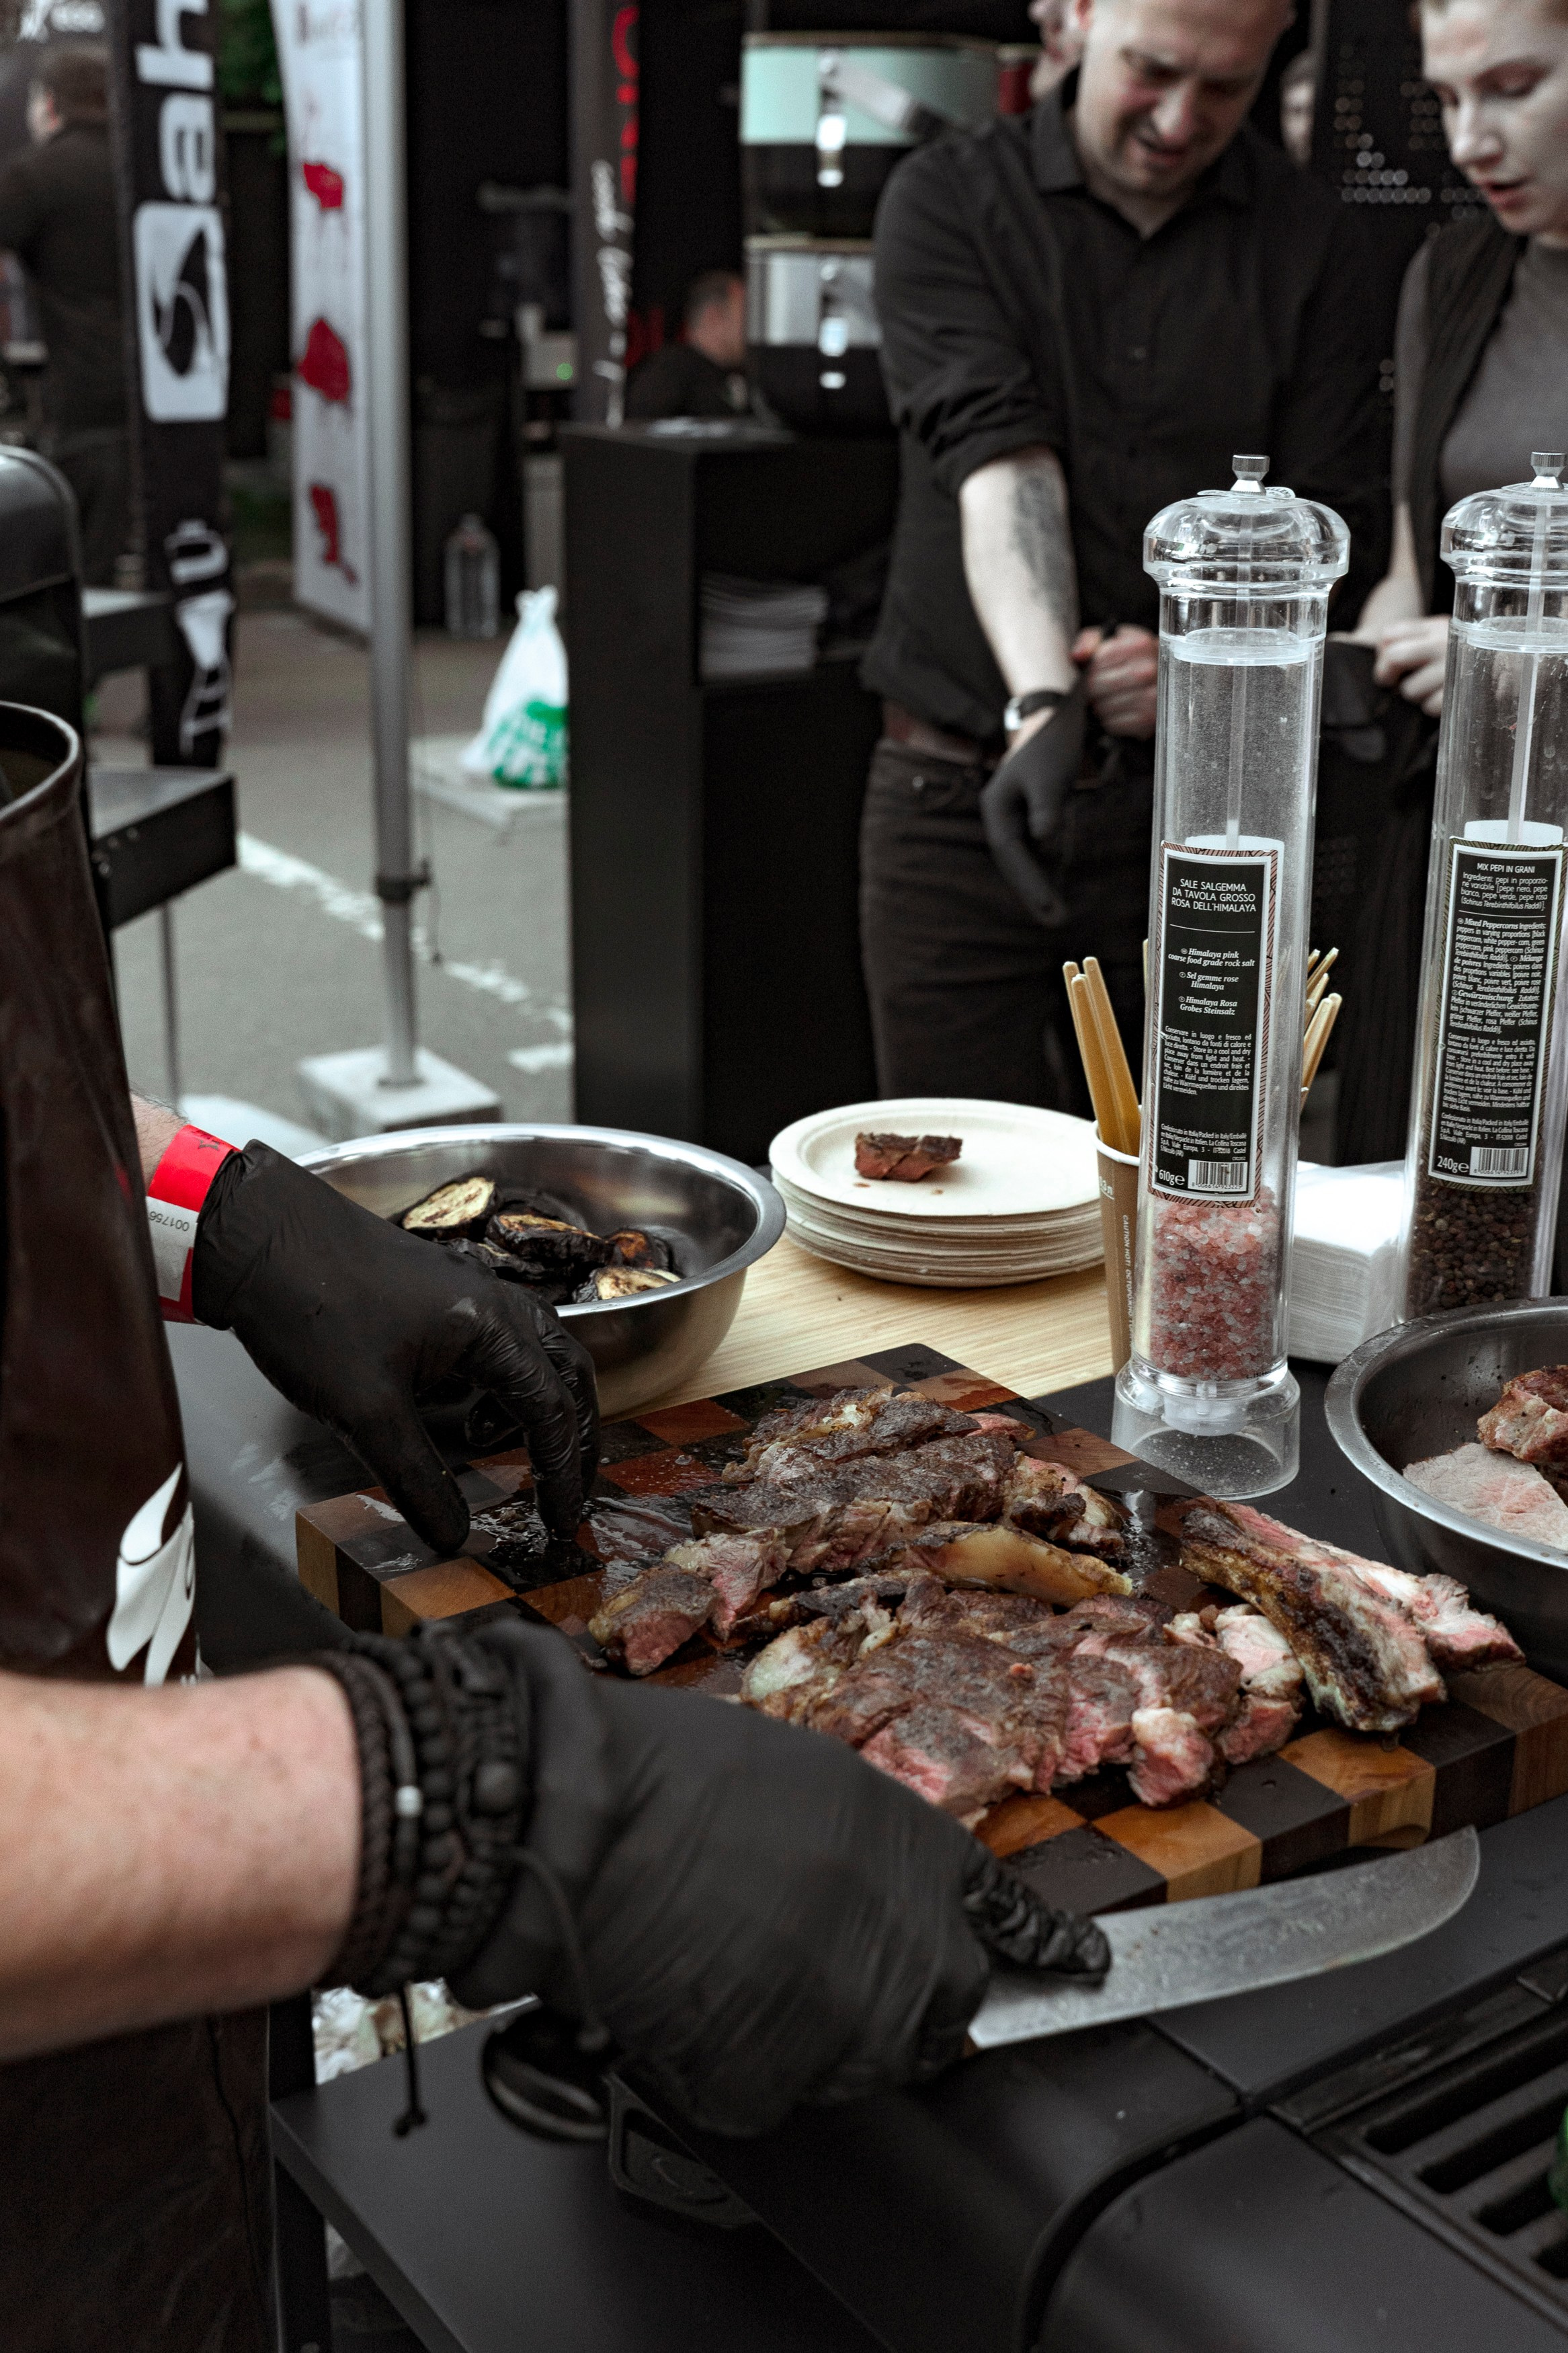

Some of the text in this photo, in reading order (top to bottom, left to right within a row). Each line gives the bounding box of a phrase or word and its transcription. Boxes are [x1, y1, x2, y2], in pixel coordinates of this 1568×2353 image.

[1180, 879, 1247, 891] SALE SALGEMMA
[1172, 887, 1255, 902] DA TAVOLA GROSSO
[1171, 898, 1191, 908] ROSA
[1188, 948, 1222, 959] Himalaya
[1223, 951, 1239, 959] pink
[1168, 954, 1186, 962] coarse
[1186, 956, 1202, 965] food
[1202, 958, 1223, 967] grade
[1186, 971, 1196, 980] Sel
[1197, 975, 1223, 983] gemme
[1191, 980, 1225, 992] Himalaya
[1180, 1003, 1202, 1013] Grobes
[1186, 996, 1219, 1008] Himalaya
[149, 1211, 190, 1232] 001756
[1122, 1215, 1130, 1247] CAUTION
